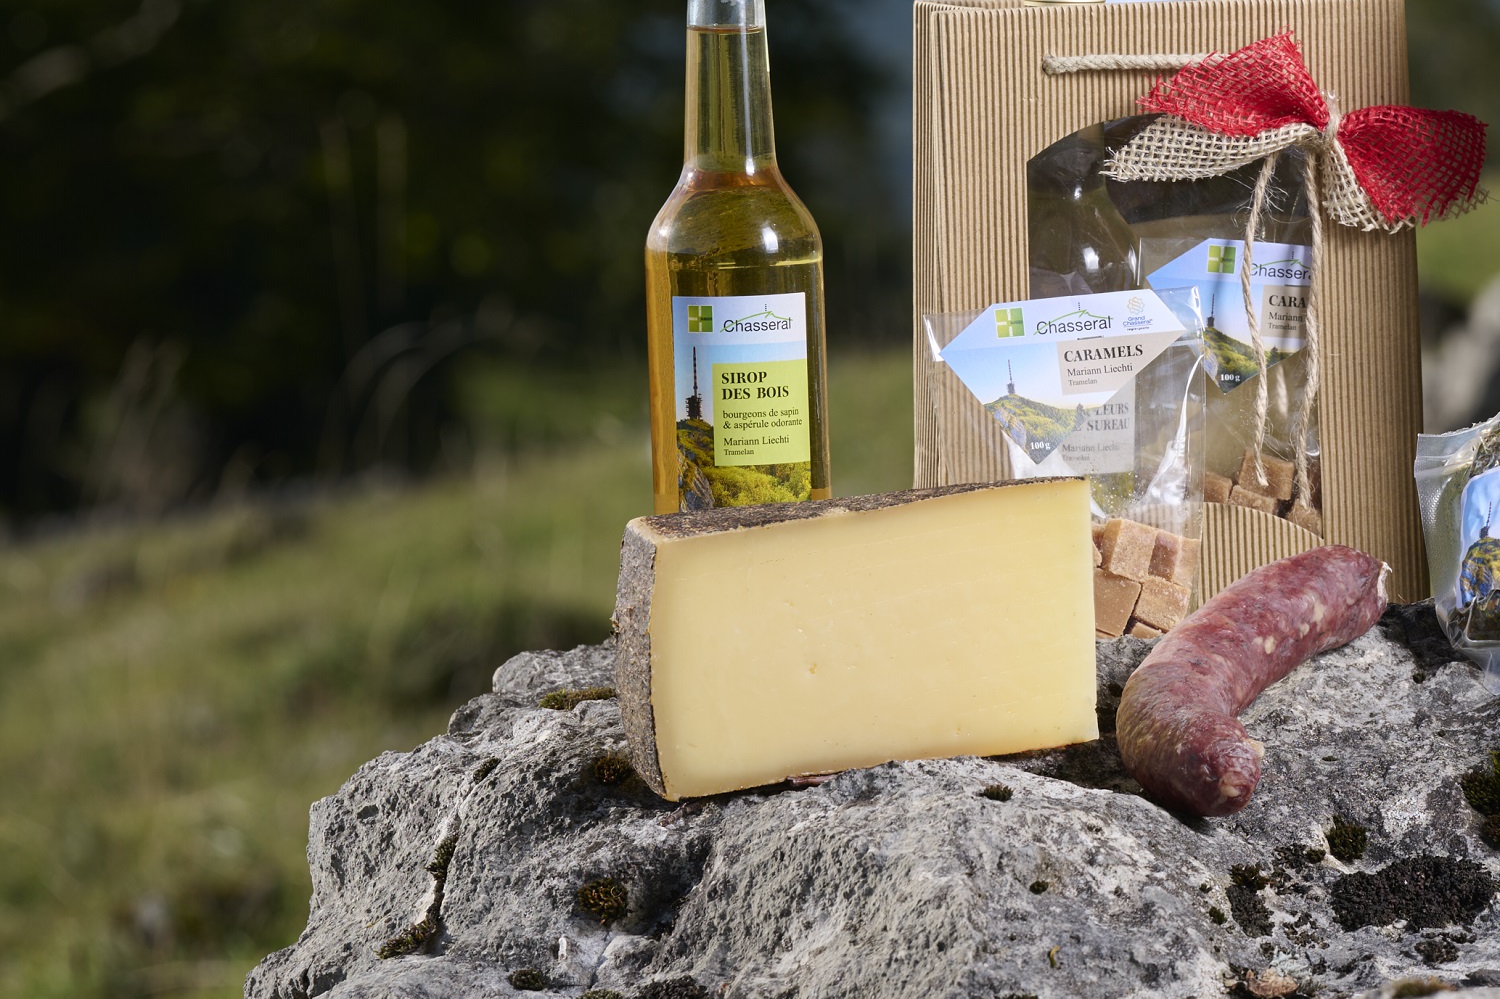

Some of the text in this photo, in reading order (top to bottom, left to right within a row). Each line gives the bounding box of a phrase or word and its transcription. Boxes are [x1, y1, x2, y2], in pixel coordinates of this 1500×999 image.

[1269, 295, 1306, 308] CARA
[1269, 312, 1302, 322] Mariann
[724, 316, 791, 332] Chasseral
[1036, 315, 1111, 335] Chasseral
[1064, 344, 1143, 362] CARAMELS
[1067, 363, 1133, 377] Mariann Liechti
[722, 372, 767, 384] SIROP
[1069, 378, 1097, 386] Tramelan
[722, 386, 789, 400] DES BOIS
[723, 410, 766, 420] bourgeons
[781, 407, 799, 417] sapin
[723, 419, 802, 430] & aspérule odorante
[1087, 418, 1130, 432] SUREAU
[724, 435, 789, 446] Mariann Liechti
